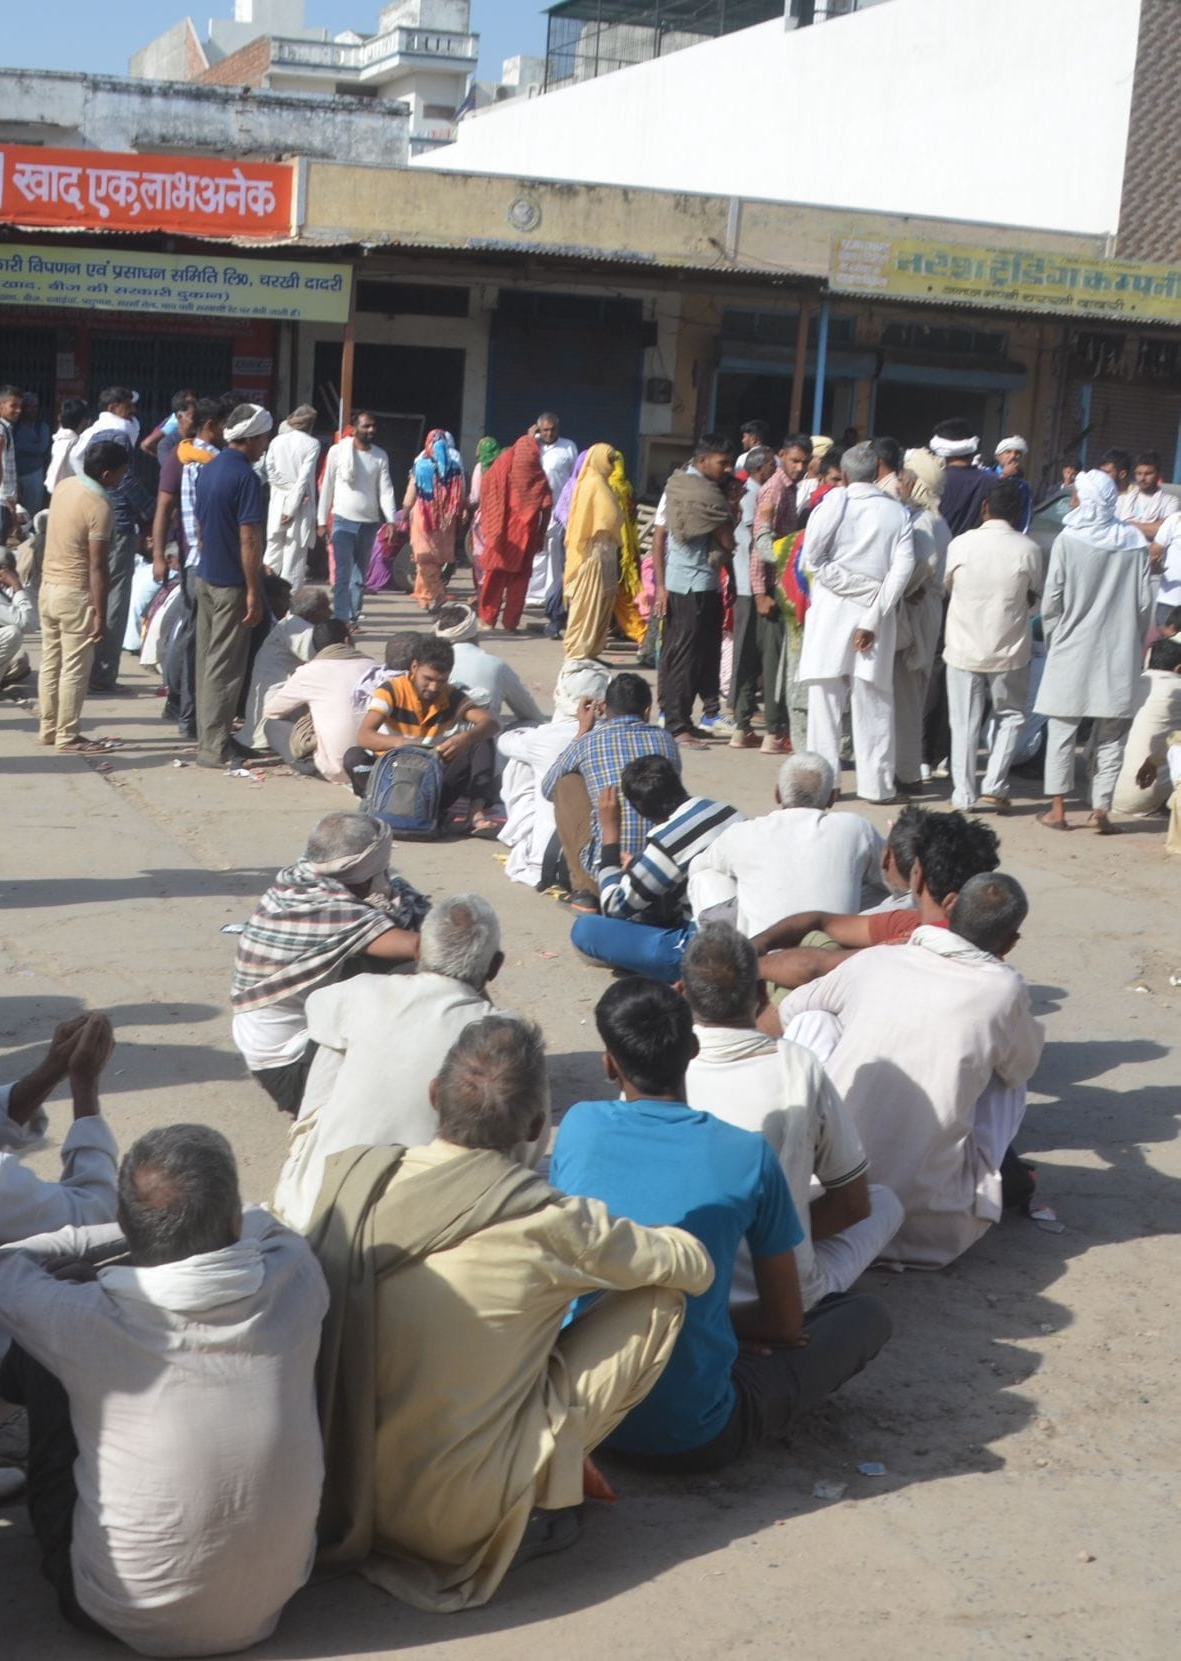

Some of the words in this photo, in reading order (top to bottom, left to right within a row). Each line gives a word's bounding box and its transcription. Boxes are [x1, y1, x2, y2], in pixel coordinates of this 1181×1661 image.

[28, 255, 80, 276] विपणन
[86, 260, 111, 277] एवं
[112, 264, 167, 281] प्रसाधन
[171, 265, 218, 284] समिति
[259, 271, 300, 290] चरखी
[304, 274, 343, 292] दादरी
[48, 281, 81, 292] बीज
[87, 282, 108, 293] की
[114, 286, 172, 297] सरकारी
